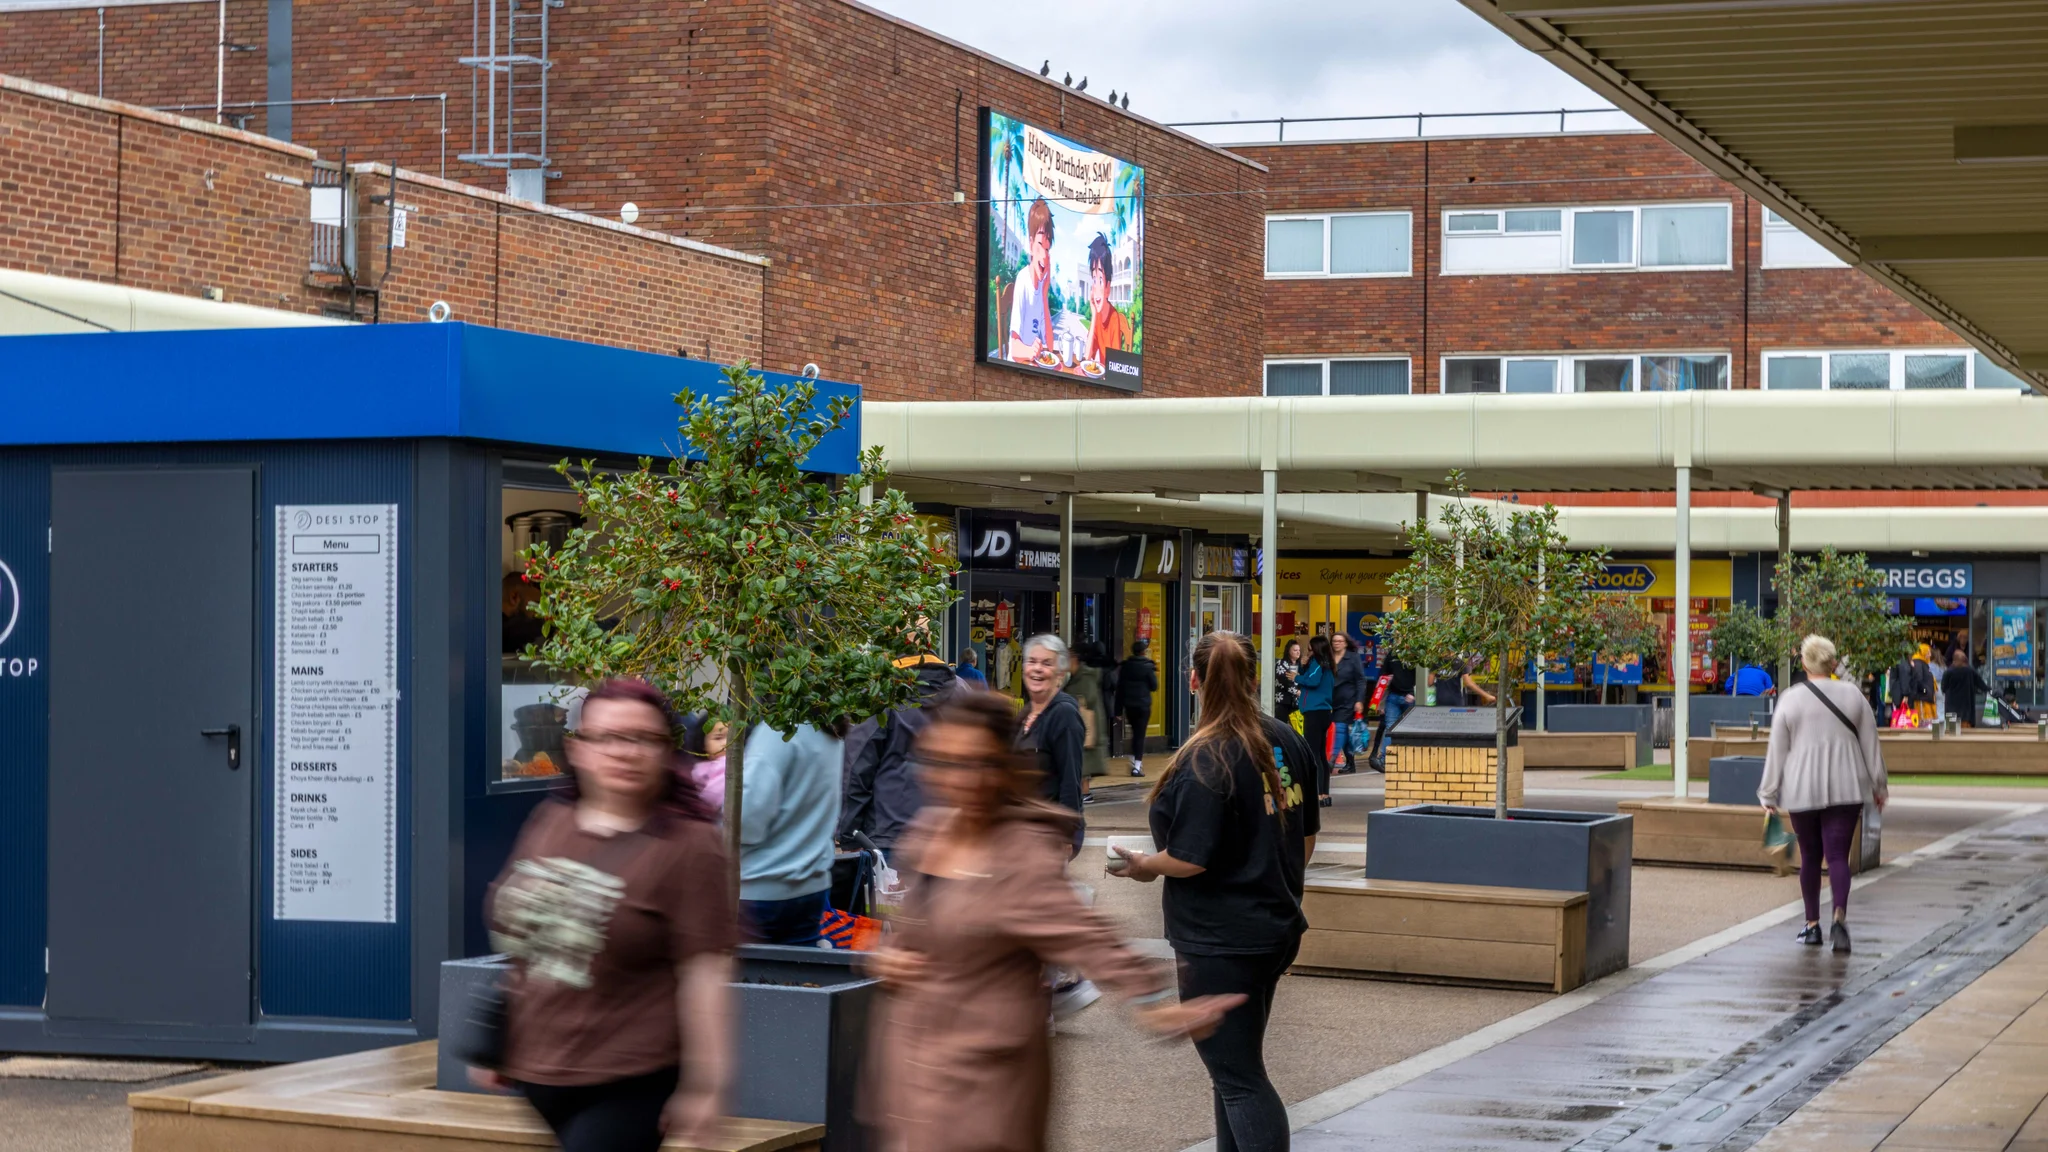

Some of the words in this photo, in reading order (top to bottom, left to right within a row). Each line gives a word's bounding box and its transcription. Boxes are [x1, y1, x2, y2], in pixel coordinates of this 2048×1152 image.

[1056, 151, 1090, 184] Birthday,
[1093, 162, 1112, 182] SAM!
[1040, 168, 1056, 195] Love,
[1058, 178, 1074, 200] Mum
[1076, 187, 1087, 204] and
[1088, 188, 1101, 205] Dad
[316, 515, 343, 525] DESI
[350, 515, 379, 524] STOP
[323, 540, 349, 549] Menu
[974, 530, 1011, 557] JD
[1024, 550, 1060, 569] TRAINERS
[1157, 540, 1174, 574] JD
[291, 562, 338, 572] STARTERS
[1320, 568, 1342, 584] Right
[1345, 572, 1353, 584] up
[1354, 572, 1377, 584] your
[1597, 568, 1646, 587] oods
[291, 666, 324, 676] MAINS
[290, 762, 337, 772] DESSERTS
[290, 793, 327, 803] DRINKS
[290, 849, 318, 859] SIDES
